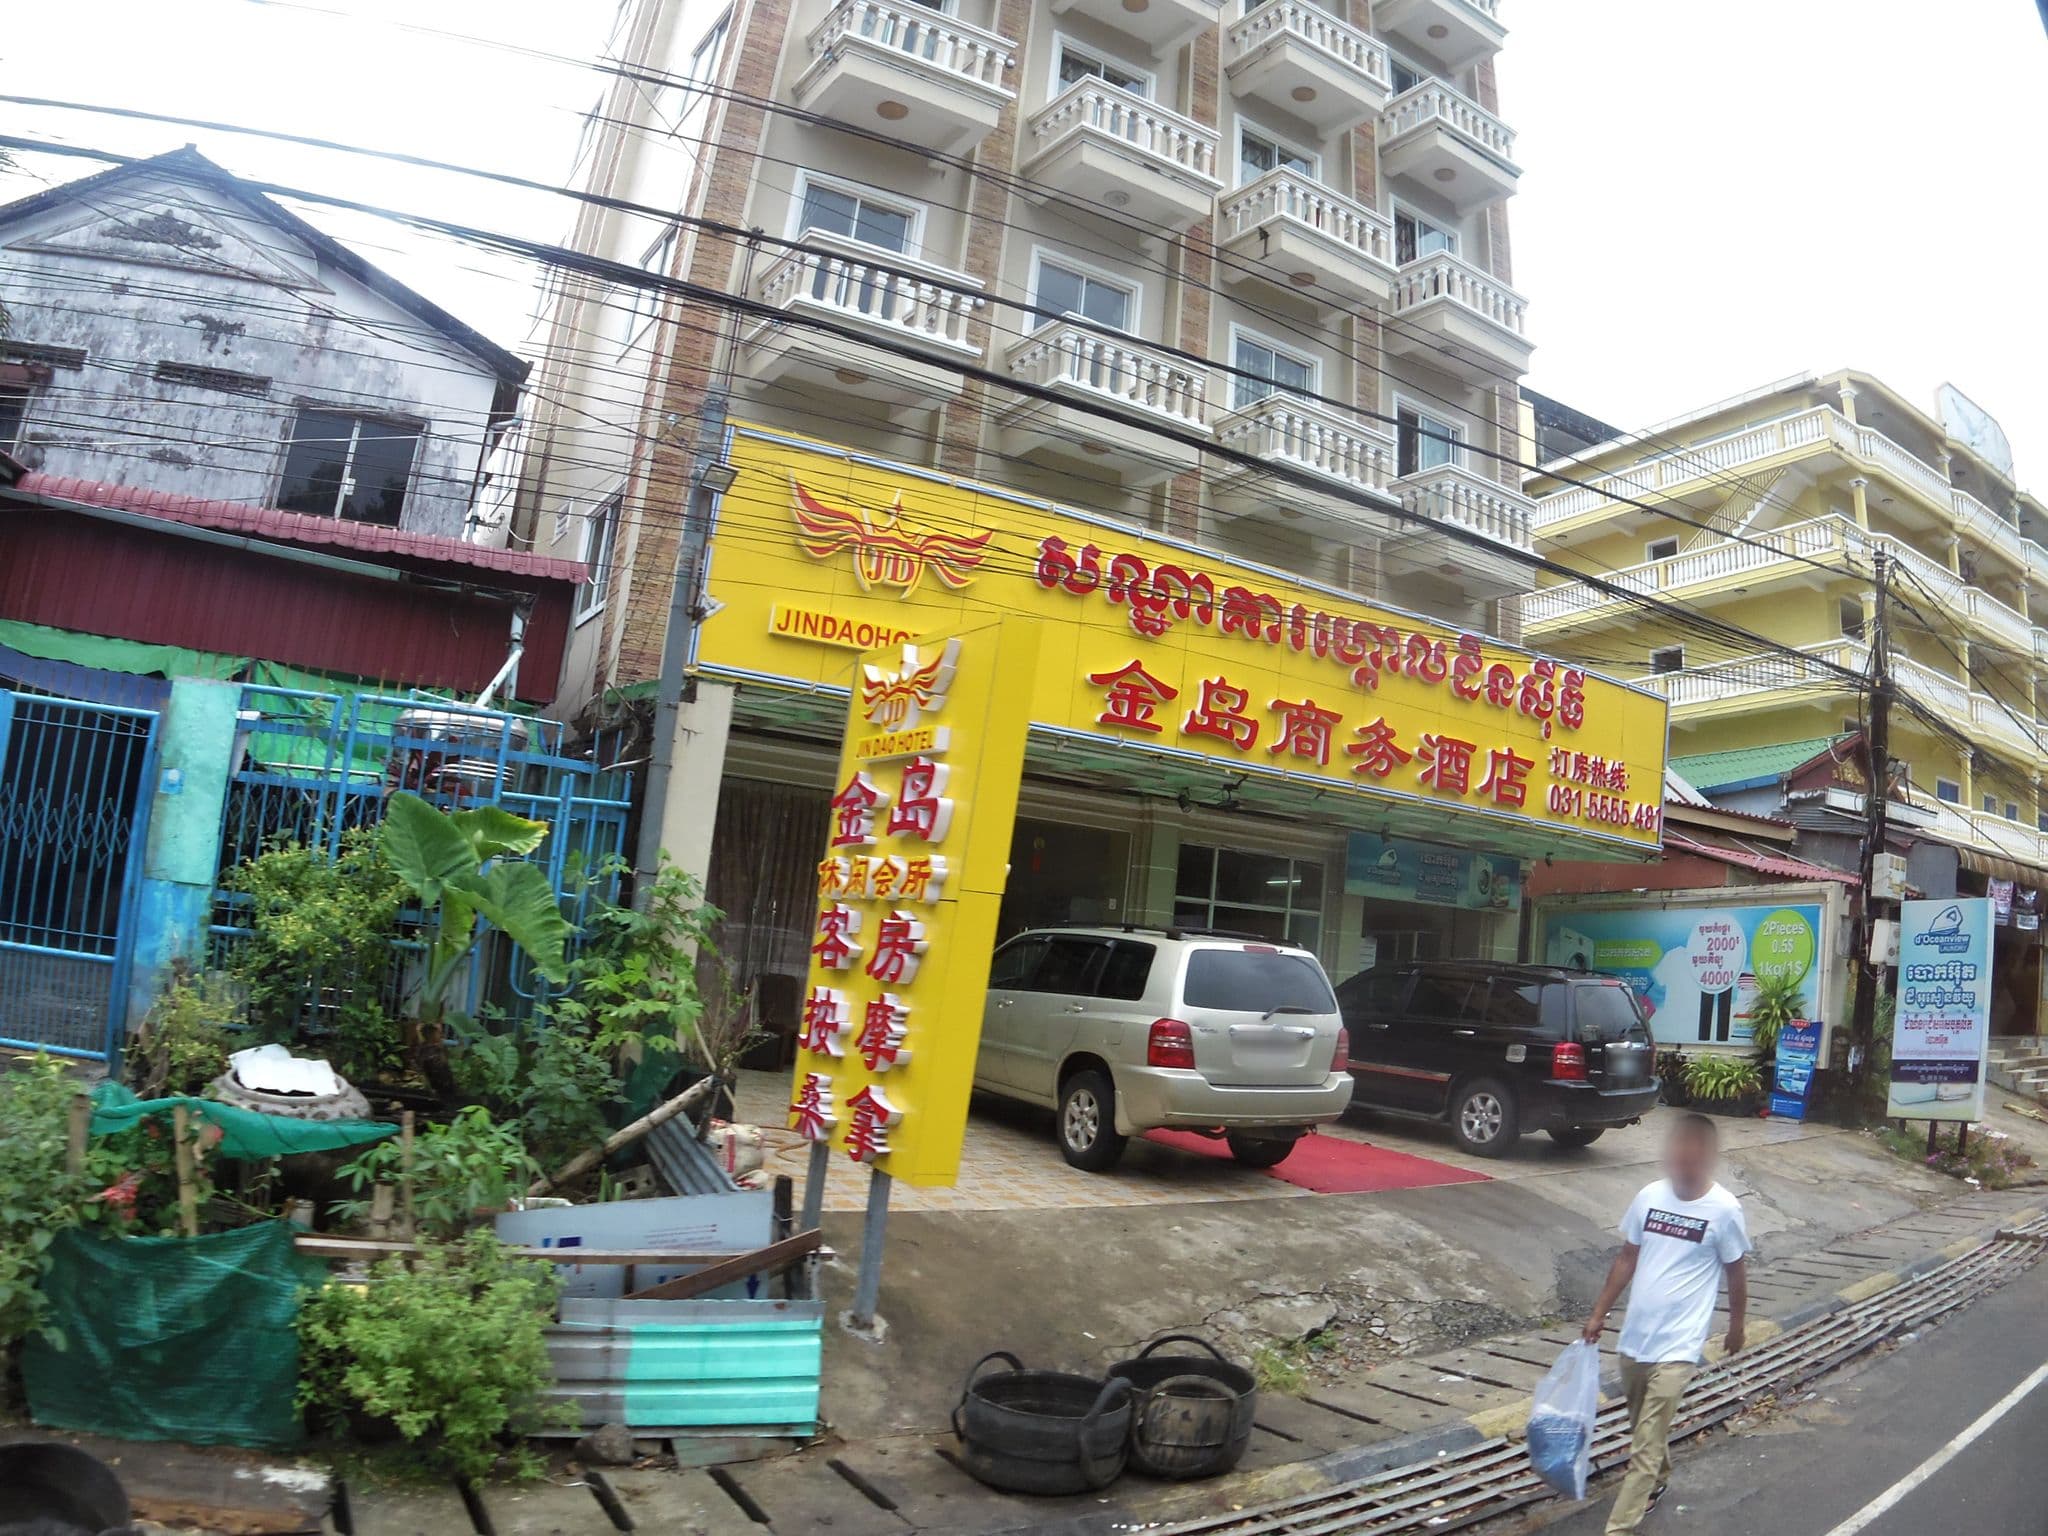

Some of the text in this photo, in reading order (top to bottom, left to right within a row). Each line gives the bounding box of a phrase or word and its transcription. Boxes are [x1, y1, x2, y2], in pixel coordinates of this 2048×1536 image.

[777, 609, 921, 649] JINDAOH
[899, 730, 933, 752] HOTEL
[1087, 659, 1535, 808] 金岛商务酒店
[831, 757, 946, 847] 金岛
[1549, 784, 1582, 818] 031
[1587, 791, 1630, 826] 5555
[818, 856, 940, 902] 休闲会所
[812, 904, 921, 983] 客房
[799, 988, 906, 1072] 按摩
[790, 1073, 898, 1162] 桑拿
